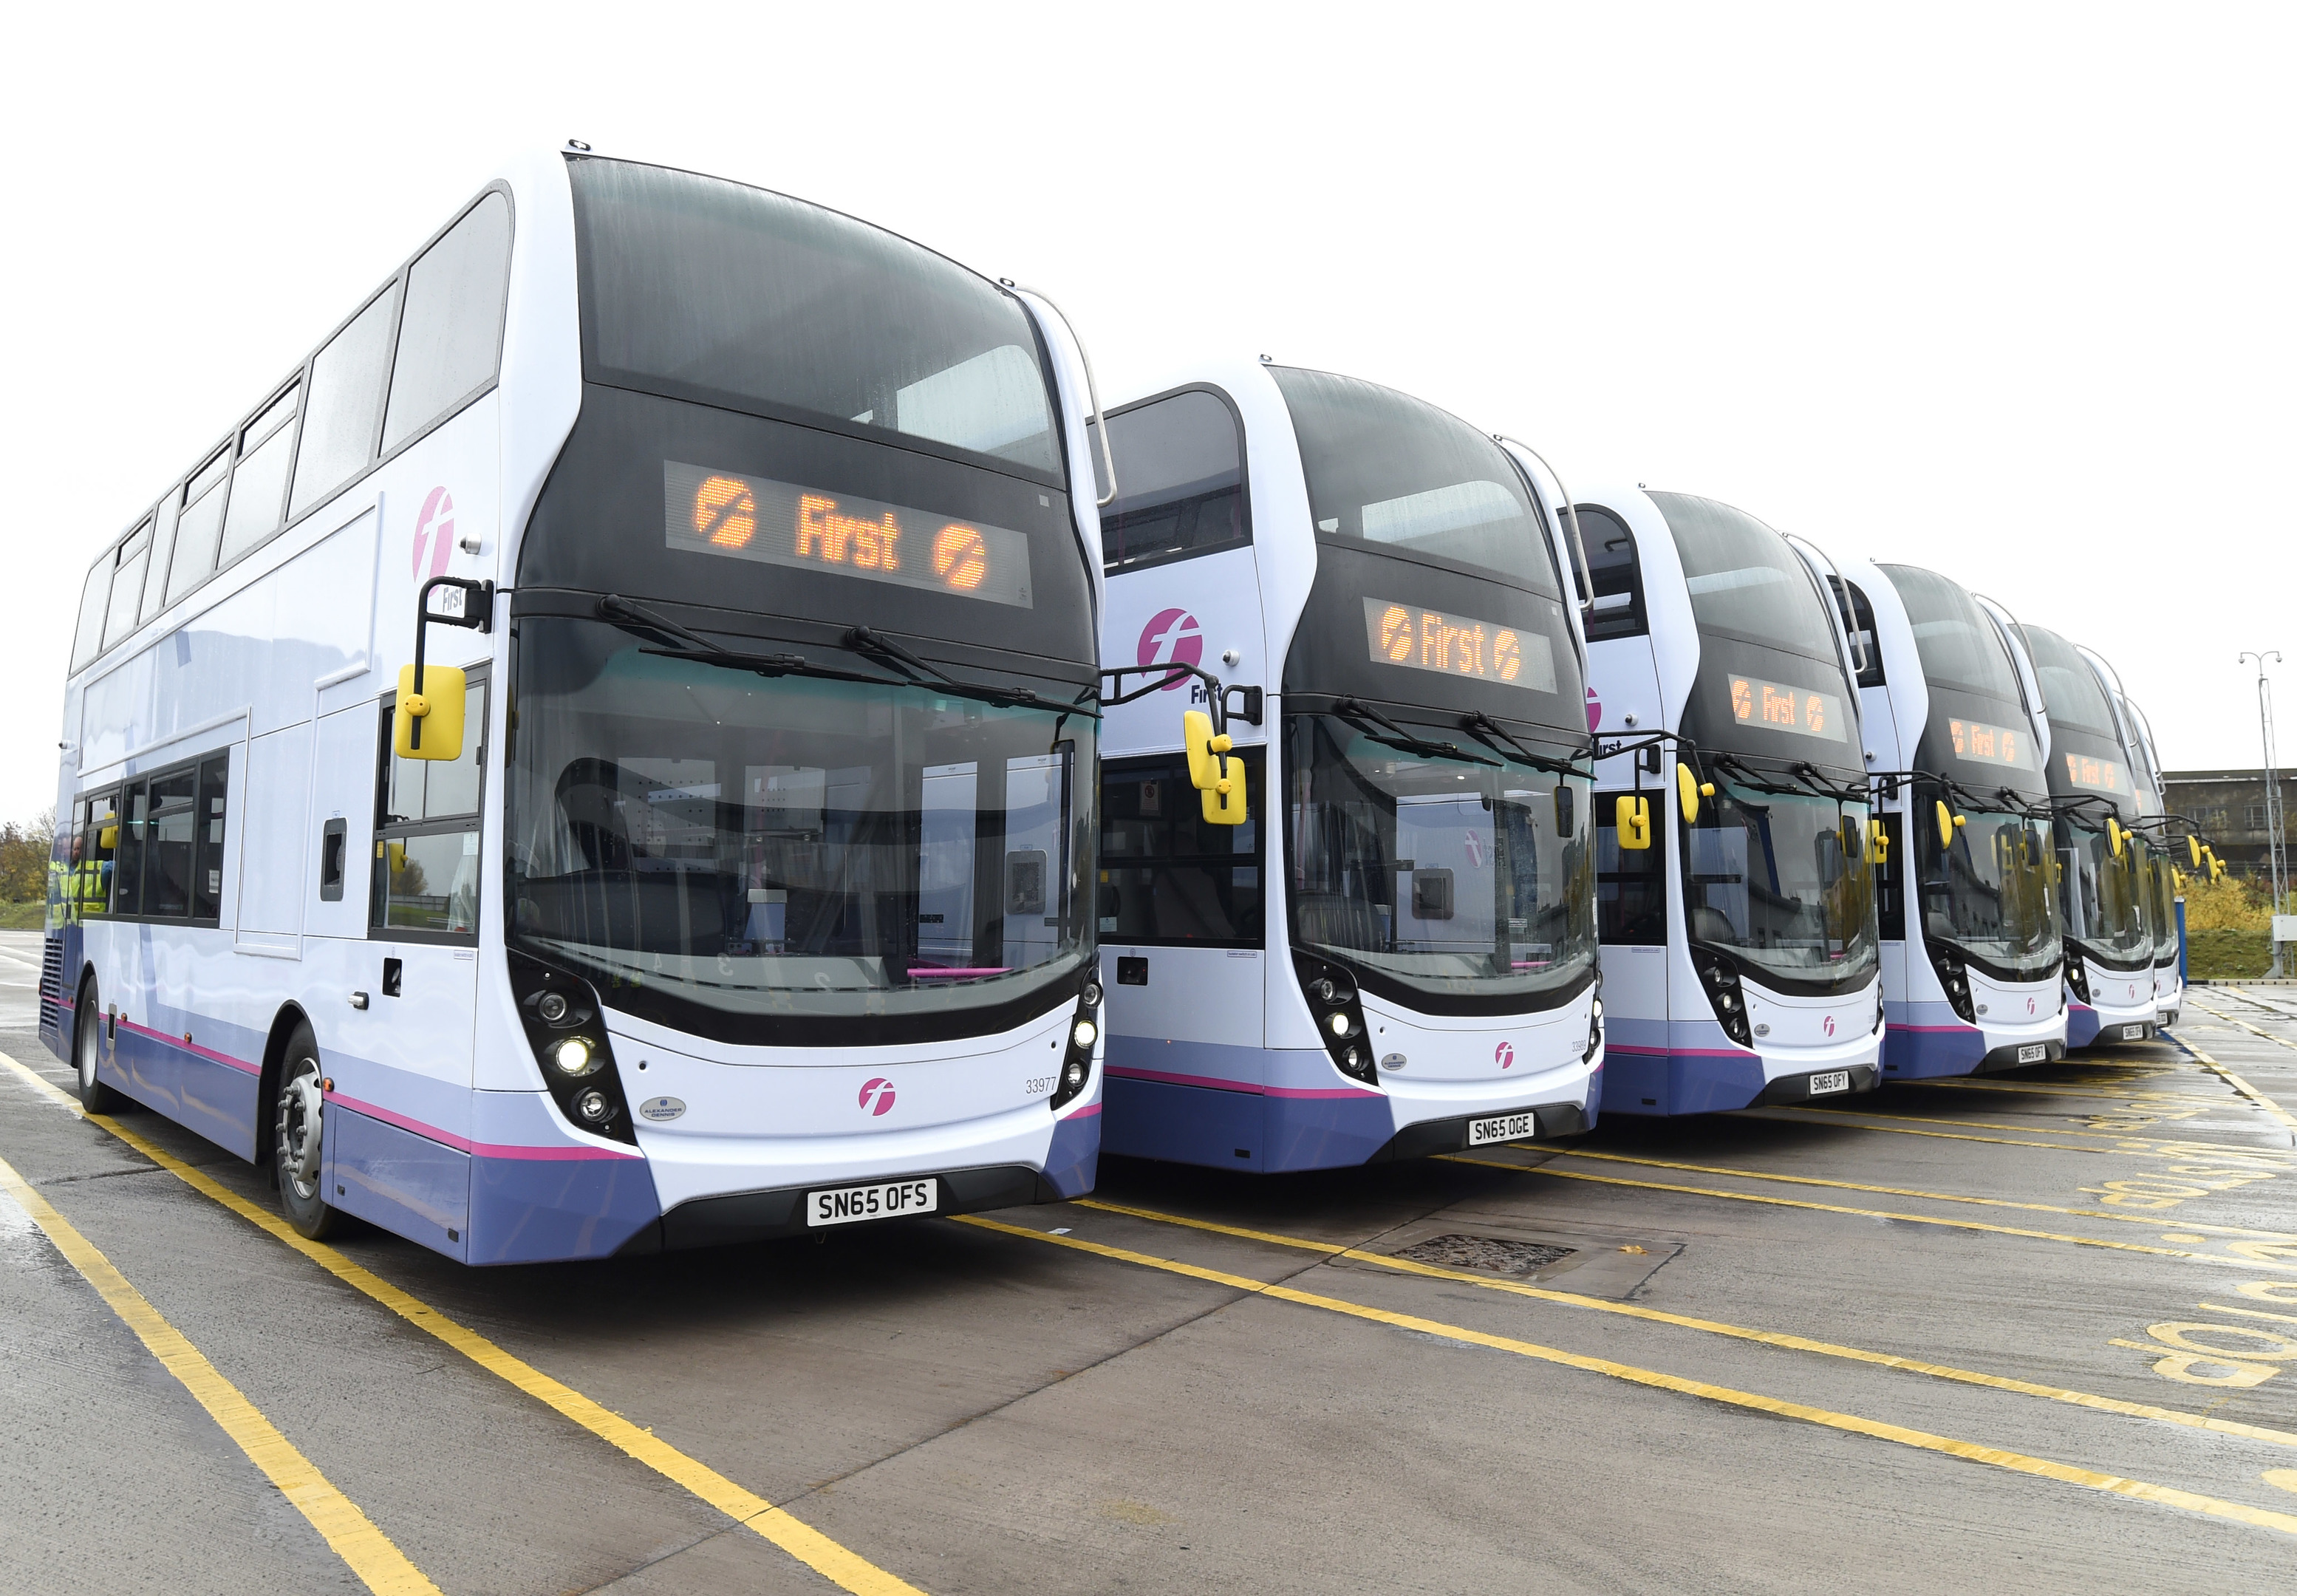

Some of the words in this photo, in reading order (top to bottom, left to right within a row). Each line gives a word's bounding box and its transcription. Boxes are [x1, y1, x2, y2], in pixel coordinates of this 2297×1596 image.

[799, 495, 898, 570] First
[443, 586, 463, 613] First
[1421, 613, 1484, 675] First
[1190, 683, 1223, 704] Firt
[1763, 686, 1795, 725] First
[1599, 740, 1622, 754] irst
[1970, 725, 1995, 757] First
[1025, 1076, 1057, 1094] 33977
[1814, 1075, 1832, 1091] SN65
[1833, 1072, 1846, 1088] OFY
[1475, 1119, 1506, 1140] SN65
[1509, 1115, 1529, 1136] OGE
[819, 1188, 878, 1219] SN65
[887, 1182, 927, 1211] OFS
